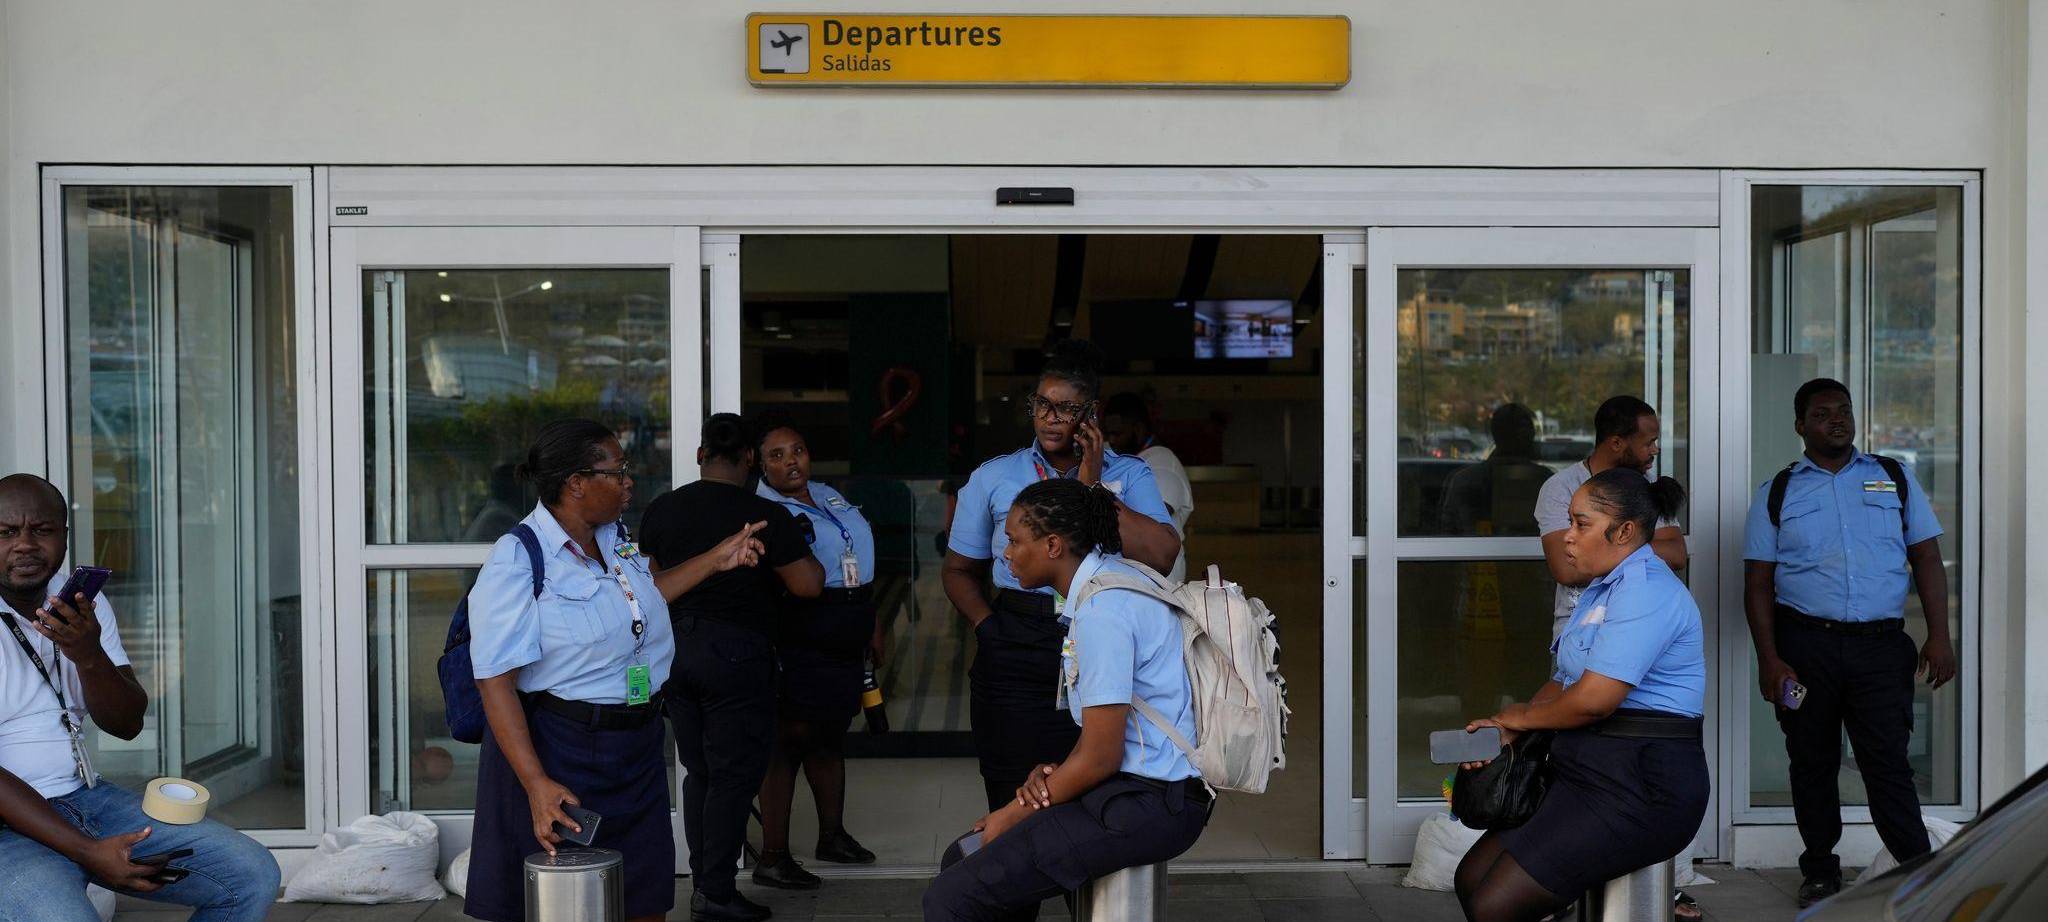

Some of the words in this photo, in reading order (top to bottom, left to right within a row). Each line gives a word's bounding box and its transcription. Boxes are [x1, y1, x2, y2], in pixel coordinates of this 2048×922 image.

[823, 20, 1001, 53] Departures
[823, 55, 891, 71] Salidas
[336, 207, 367, 215] STANLEY
[13, 625, 26, 642] SITA
